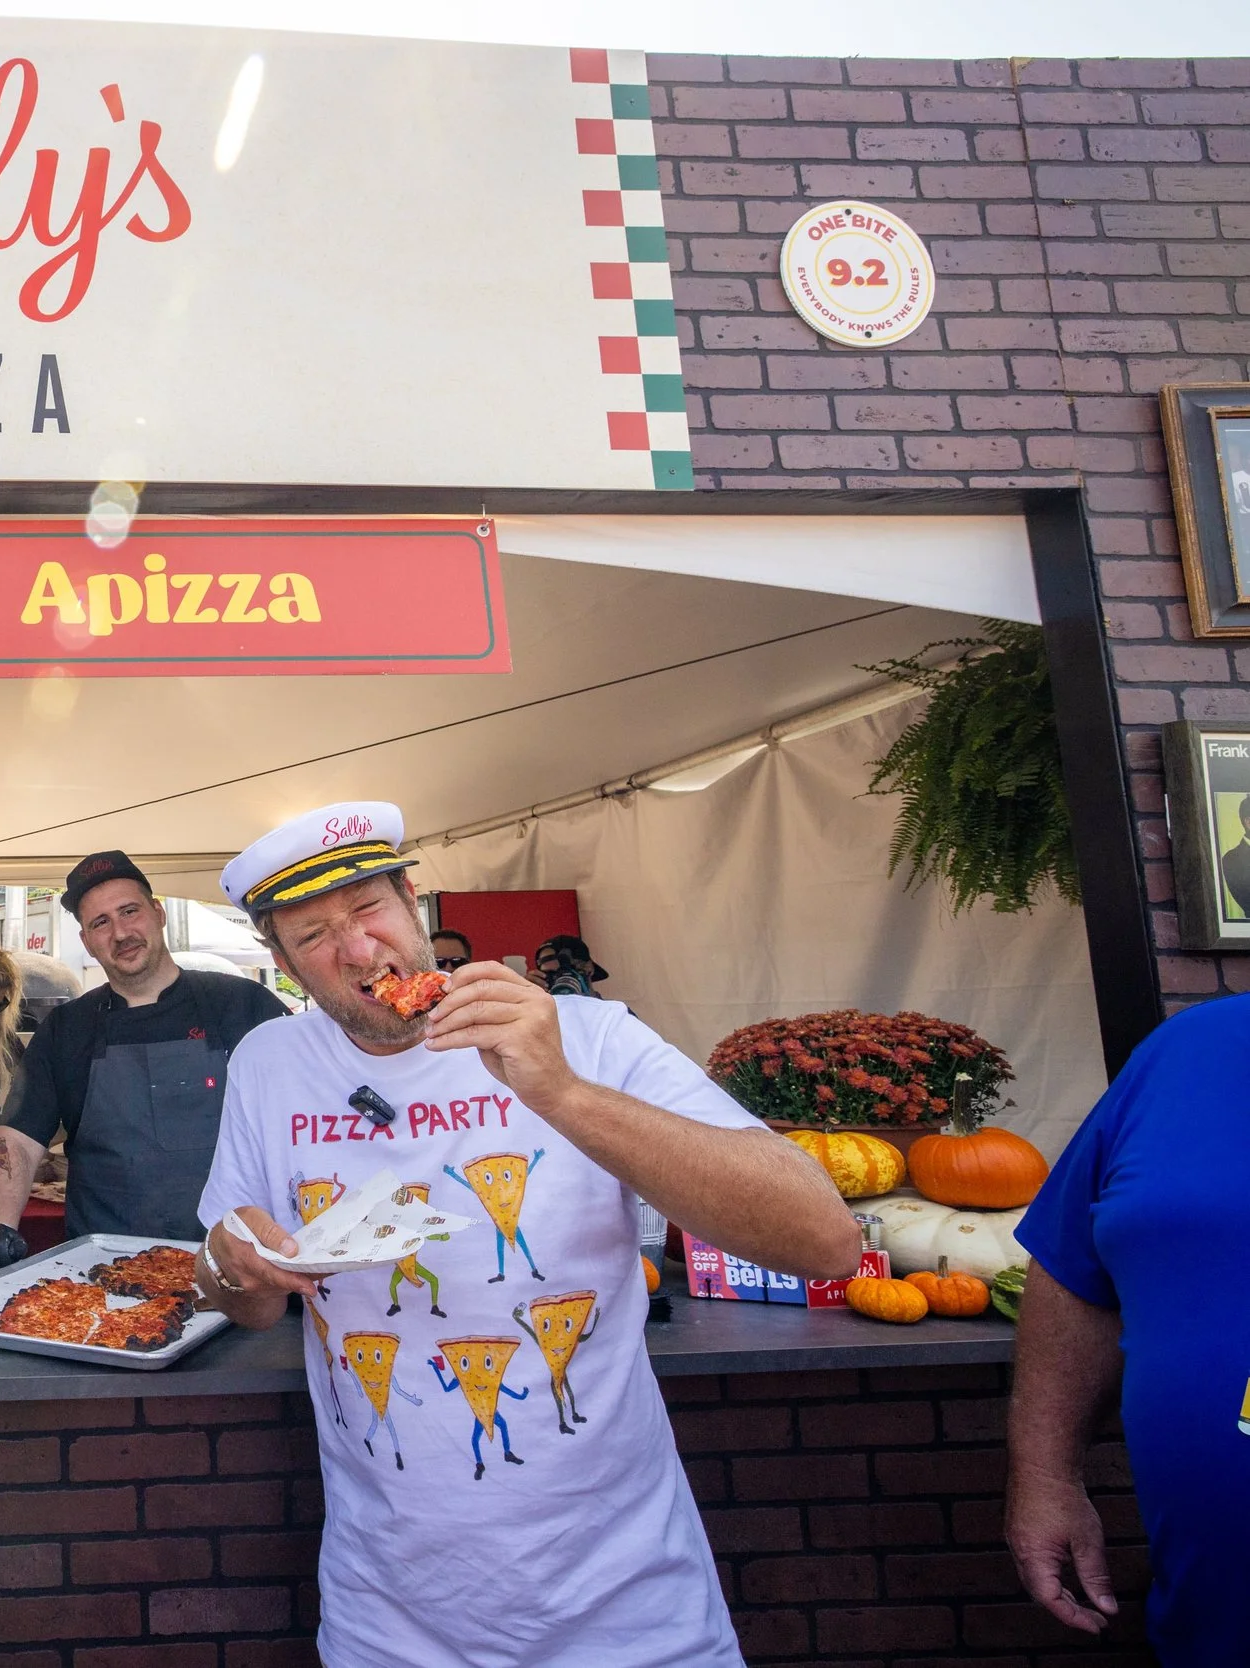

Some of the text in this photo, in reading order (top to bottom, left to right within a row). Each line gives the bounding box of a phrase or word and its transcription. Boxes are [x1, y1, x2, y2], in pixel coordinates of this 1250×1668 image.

[808, 214, 898, 243] ONE BITE
[826, 258, 889, 287] 9.2
[798, 267, 920, 332] EVERYBODY KNOWS THE RULES
[21, 553, 322, 636] Apizza
[1208, 743, 1249, 758] Frank
[322, 815, 373, 847] Sally's
[407, 1093, 512, 1139] PARTY
[691, 1250, 718, 1262] $20
[693, 1262, 719, 1272] OFF
